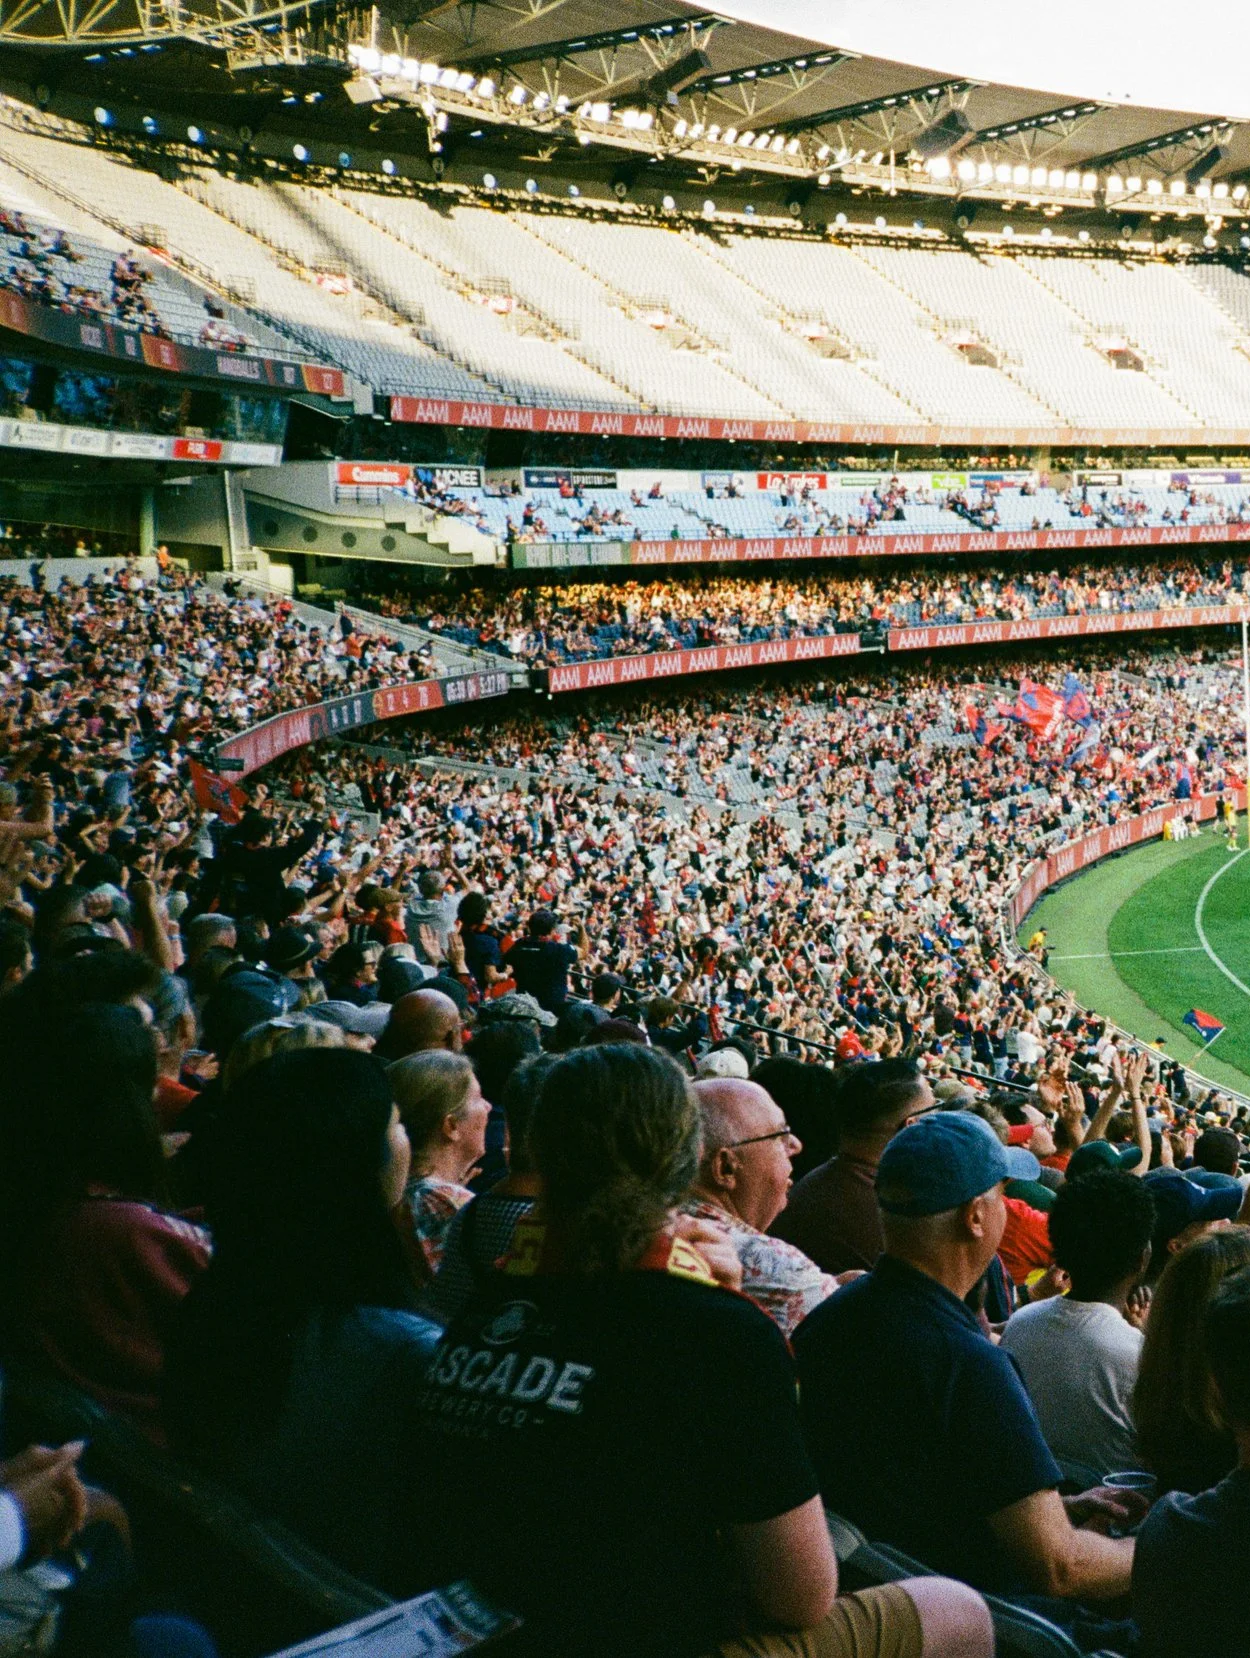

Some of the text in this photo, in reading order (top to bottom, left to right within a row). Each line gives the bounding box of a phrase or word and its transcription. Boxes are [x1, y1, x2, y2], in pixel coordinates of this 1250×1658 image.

[416, 401, 448, 422] AAMI
[462, 404, 492, 426] AAMI
[504, 406, 533, 429] AAMI
[546, 411, 579, 432] AAMI
[591, 414, 622, 434] AAMI
[634, 418, 664, 436] AAMI
[677, 419, 709, 438] AAMI
[722, 420, 754, 438] AAMI
[765, 422, 795, 440] AAMI
[808, 424, 840, 441] AAMI
[853, 426, 884, 442] AAMI
[637, 544, 664, 563] AAMI
[674, 542, 702, 562] AAMI
[710, 542, 737, 560] AAMI
[746, 540, 774, 559] AAMI
[783, 539, 812, 558] AAMI
[820, 538, 848, 556] AAMI
[857, 536, 884, 555] AAMI
[894, 536, 924, 554] AAMI
[932, 534, 960, 552] AAMI
[968, 533, 996, 551] AAMI
[1006, 532, 1036, 550] AAMI
[1046, 531, 1074, 548] AAMI
[1084, 530, 1112, 547] AAMI
[1120, 528, 1148, 545] AAMI
[1160, 527, 1190, 544] AAMI
[1200, 526, 1228, 542] AAMI
[898, 630, 928, 650] AAMI
[936, 628, 965, 646] AAMI
[973, 625, 1001, 643] AAMI
[1010, 622, 1040, 640] AAMI
[1050, 620, 1078, 636] AAMI
[1086, 616, 1115, 633] AAMI
[1124, 614, 1153, 630] AAMI
[1162, 611, 1192, 627] AAMI
[1200, 608, 1230, 624] AAMI
[552, 667, 580, 690] AAMI
[587, 664, 614, 687] AAMI
[621, 660, 646, 684] AAMI
[654, 656, 681, 680] AAMI
[688, 652, 717, 676] AAMI
[724, 649, 750, 671] AAMI
[759, 645, 787, 667] AAMI
[795, 641, 824, 662] AAMI
[1108, 825, 1130, 848] AAMI
[1142, 813, 1163, 837] AAMI
